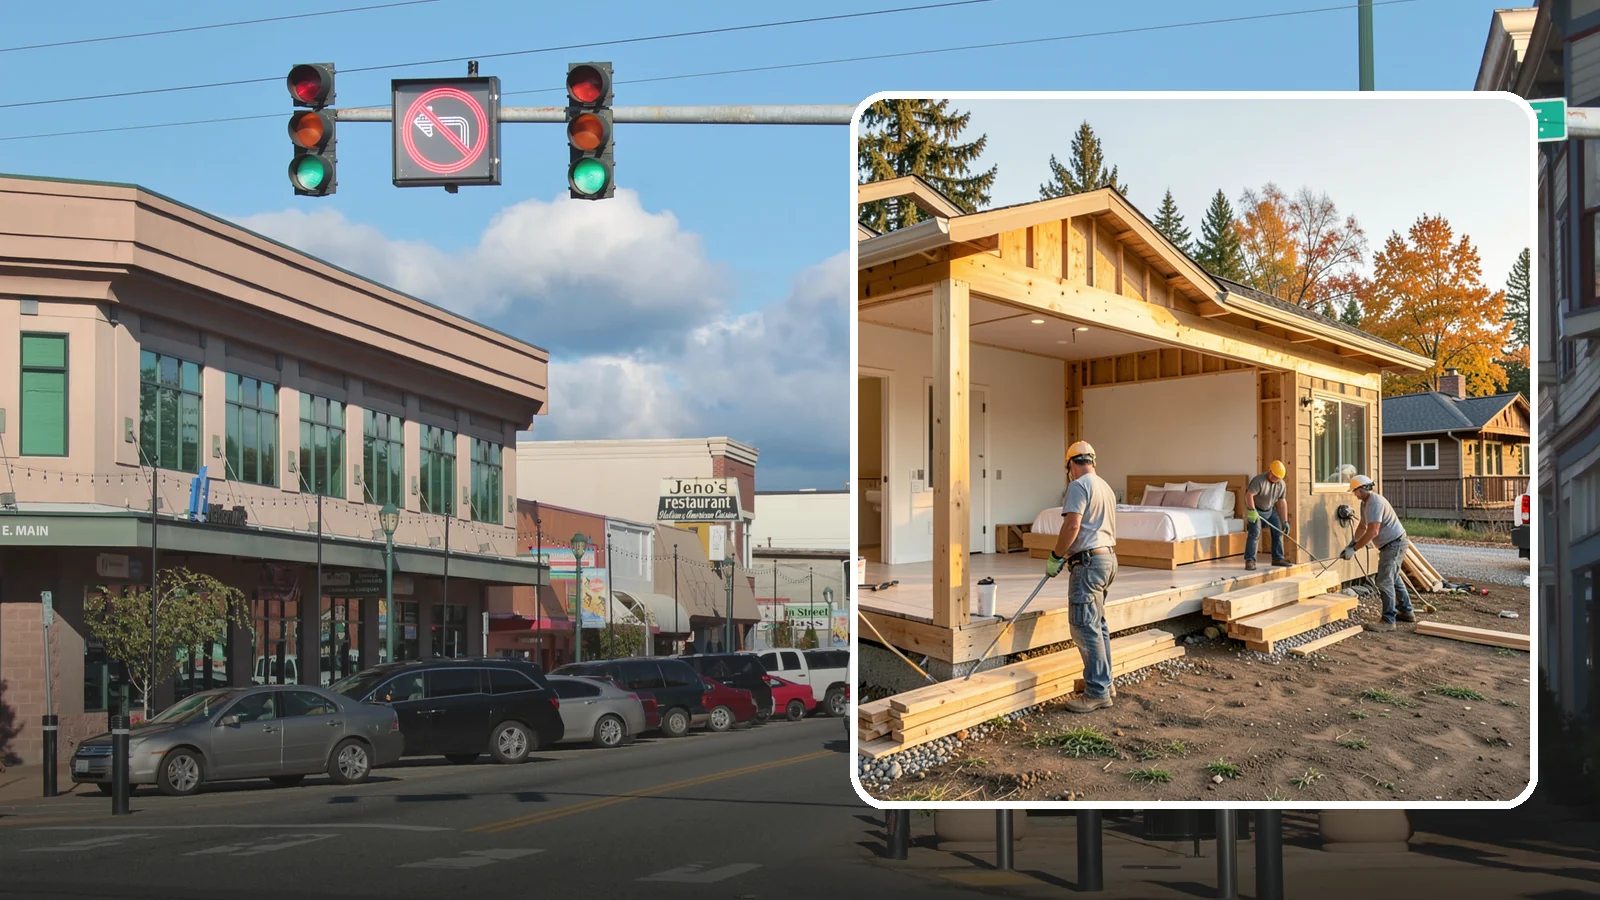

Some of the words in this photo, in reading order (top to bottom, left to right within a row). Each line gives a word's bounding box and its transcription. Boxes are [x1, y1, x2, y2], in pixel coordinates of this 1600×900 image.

[670, 480, 727, 494] Jeno's
[665, 496, 731, 509] restaurant
[686, 509, 714, 519] American
[715, 509, 737, 519] Cuisine
[2, 525, 13, 536] E.
[15, 525, 49, 536] MAIN
[797, 607, 829, 617] Street
